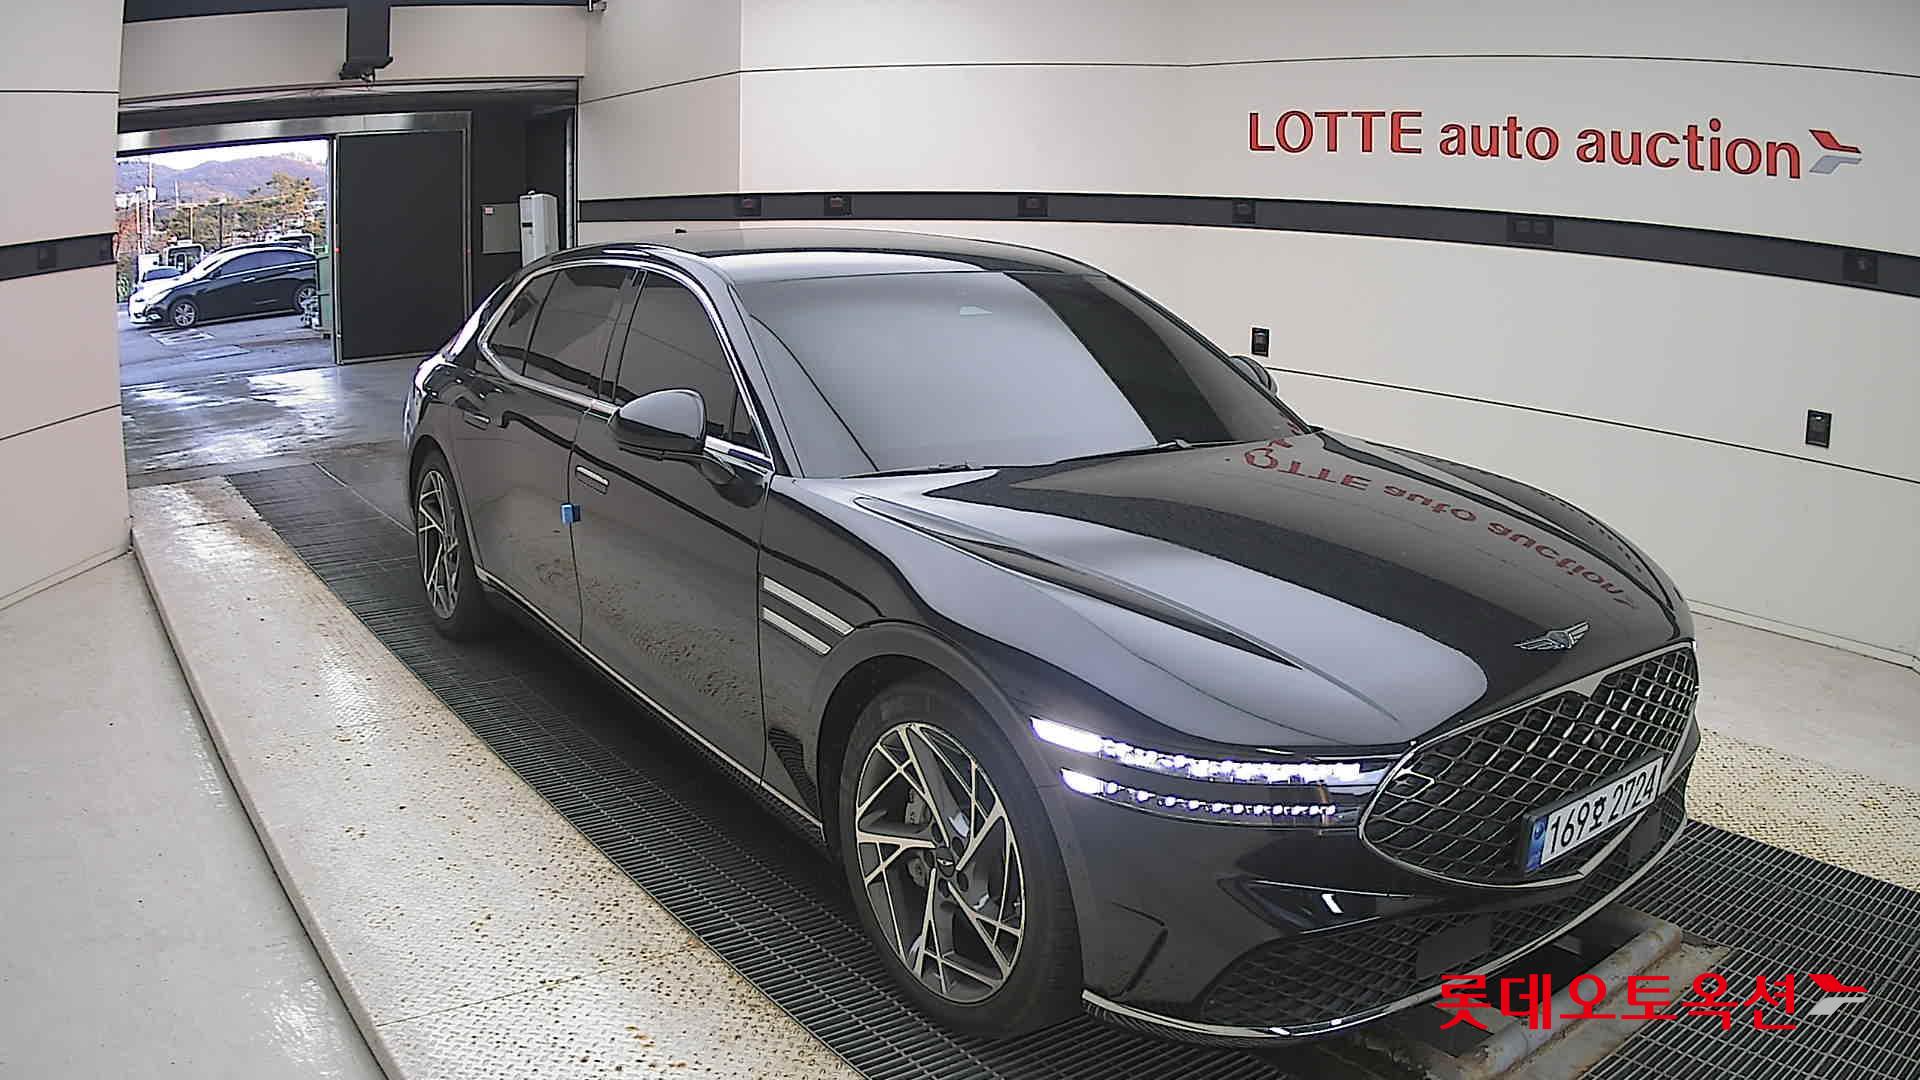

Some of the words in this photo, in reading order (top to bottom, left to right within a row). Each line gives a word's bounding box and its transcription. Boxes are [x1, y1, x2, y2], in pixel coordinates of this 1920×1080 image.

[1248, 110, 1423, 154] LOTTE
[1439, 115, 1560, 161] auto
[1575, 117, 1801, 180] auction
[1608, 764, 1658, 824] 2724
